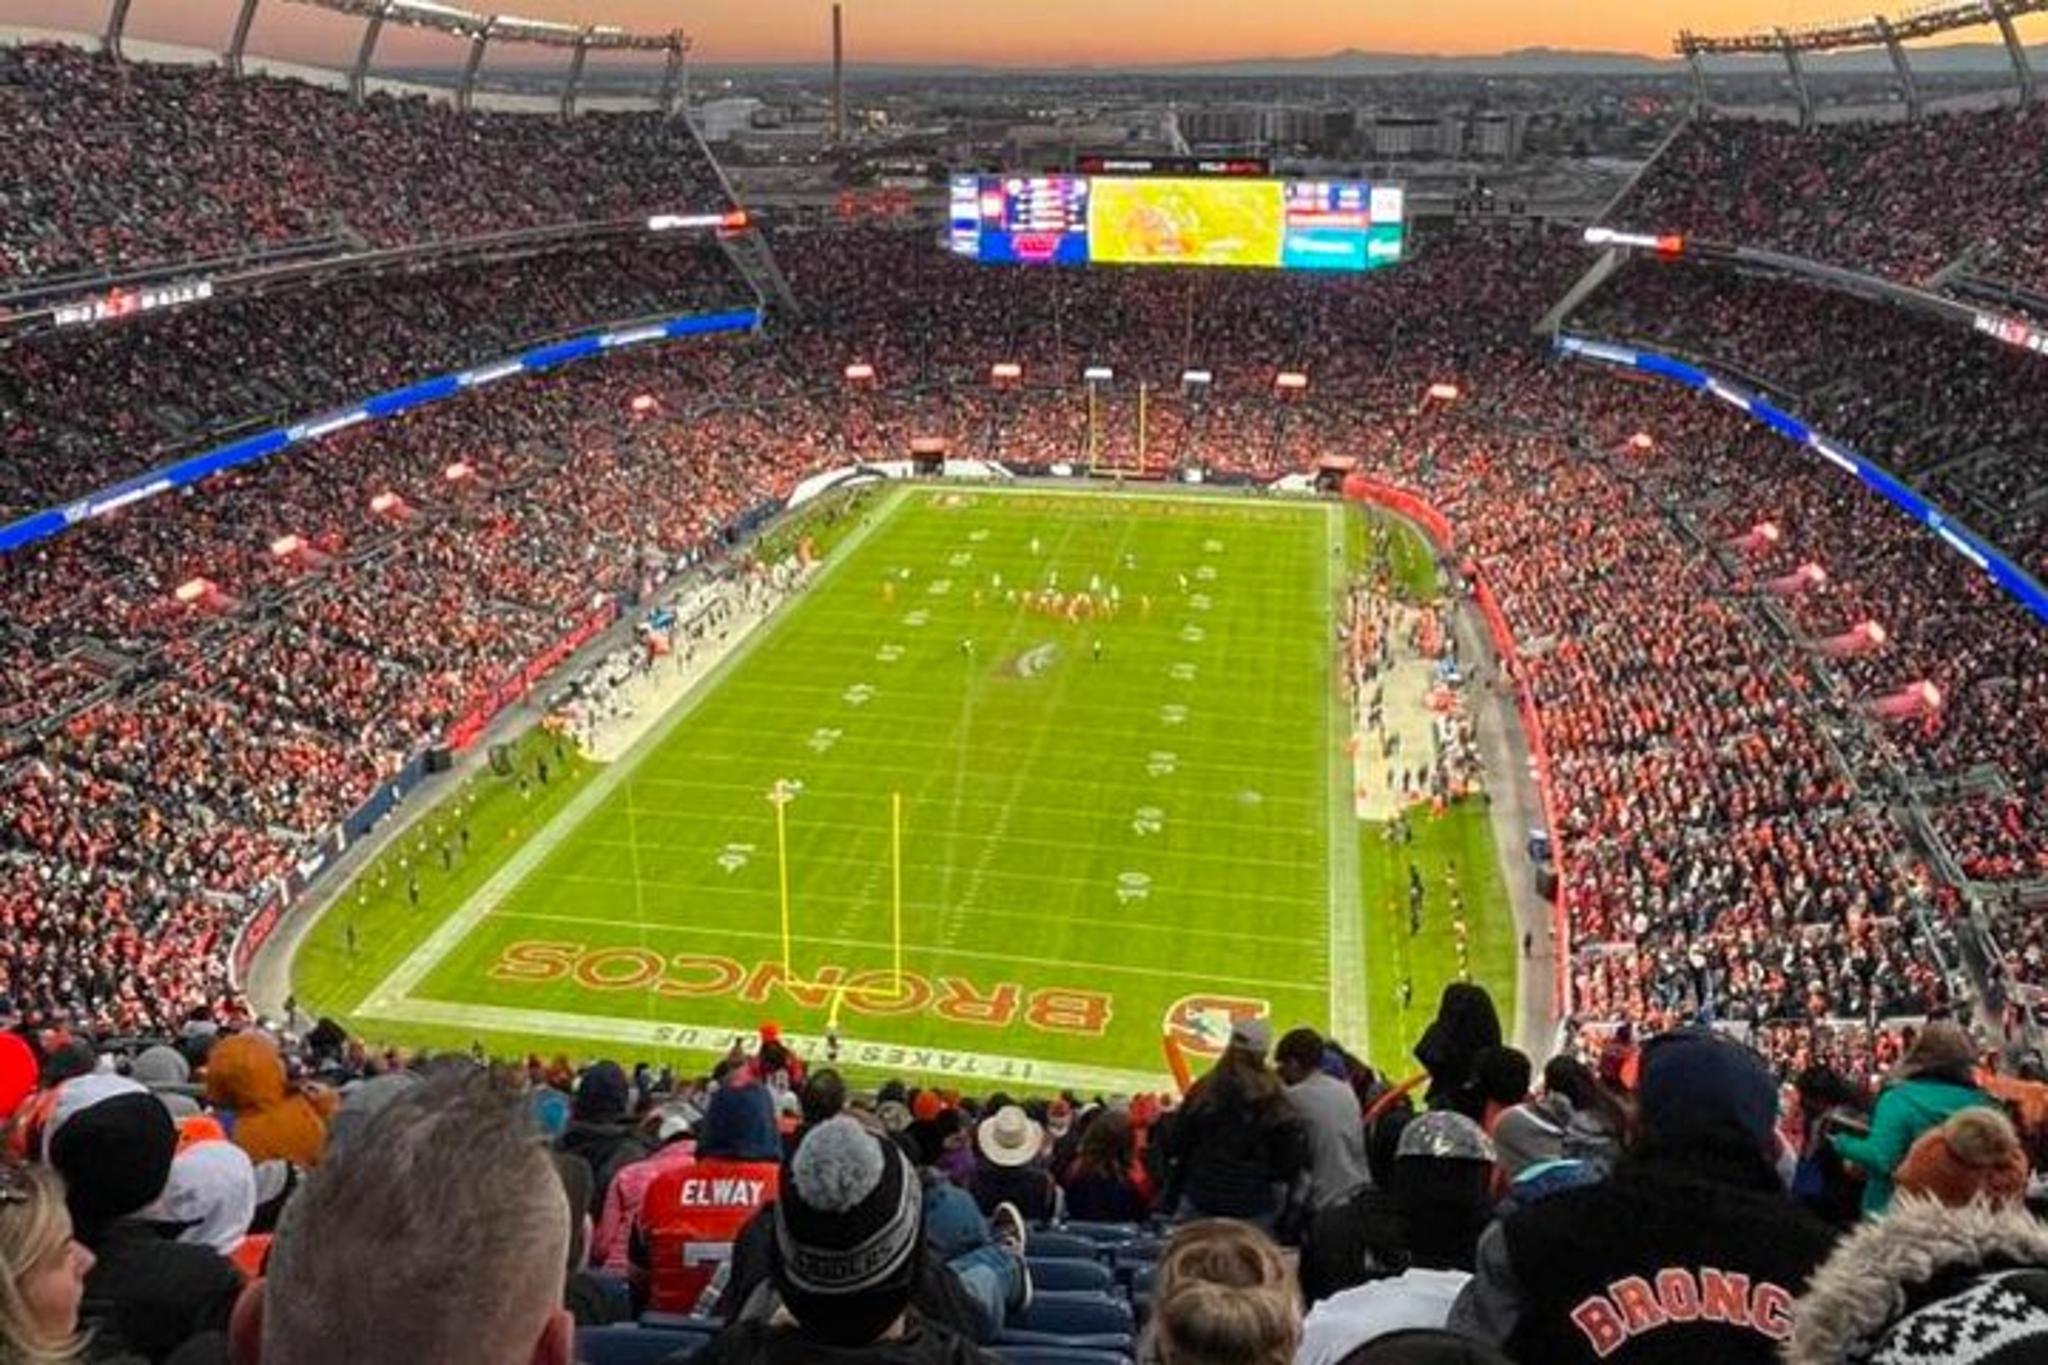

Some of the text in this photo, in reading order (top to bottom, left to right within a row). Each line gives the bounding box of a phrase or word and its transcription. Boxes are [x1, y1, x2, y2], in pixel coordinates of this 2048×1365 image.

[487, 940, 1113, 1036] BRONCOS
[655, 1025, 699, 1044] US
[861, 1045, 978, 1074] TAKES
[1000, 1060, 1034, 1079] IT
[681, 1178, 765, 1206] ELWAY
[683, 1241, 735, 1320] 7
[1569, 1266, 1797, 1357] BRONC
